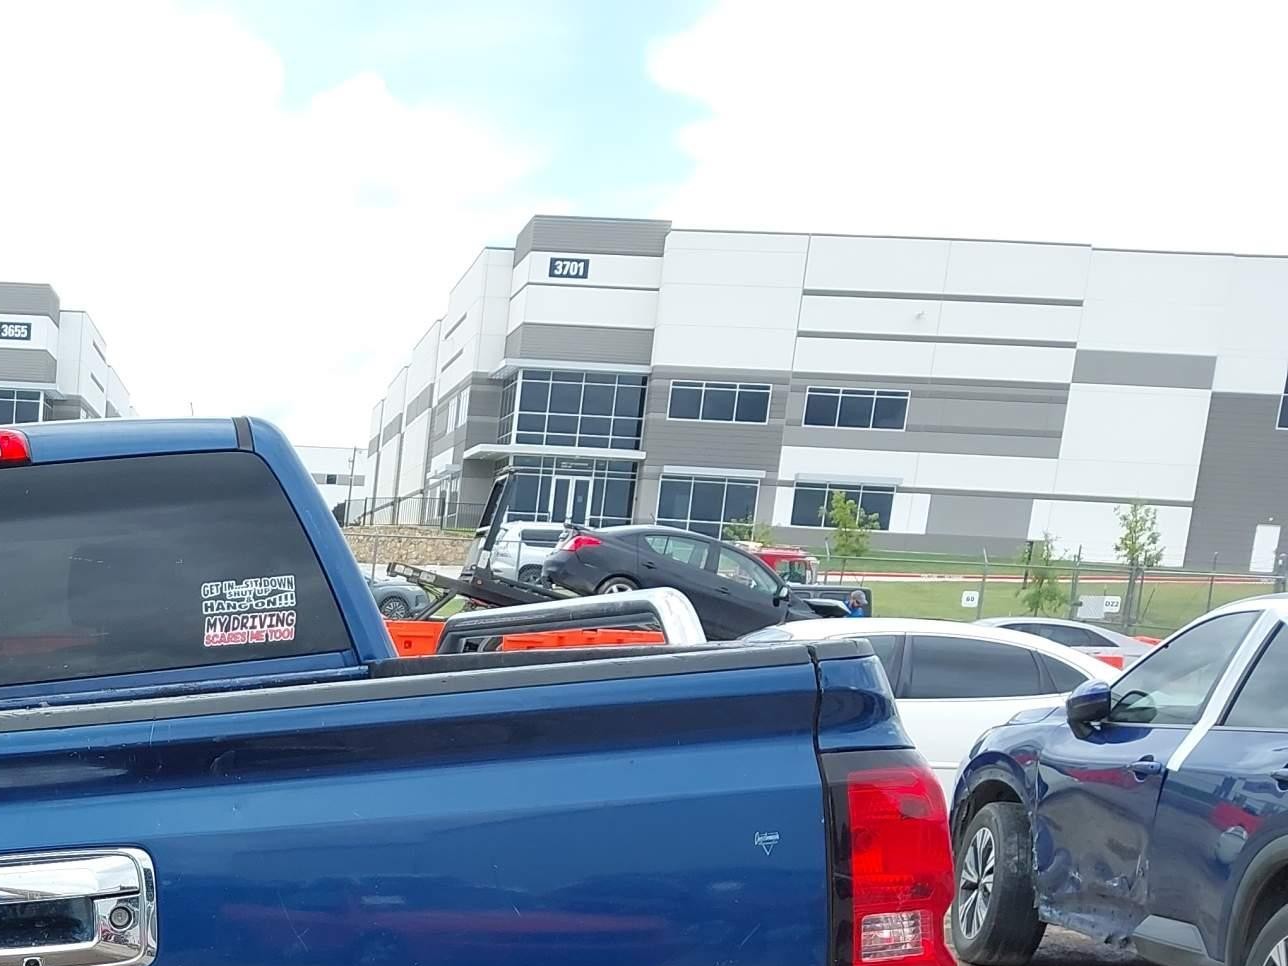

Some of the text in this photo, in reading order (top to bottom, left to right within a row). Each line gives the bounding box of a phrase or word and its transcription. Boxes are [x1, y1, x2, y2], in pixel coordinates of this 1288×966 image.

[554, 260, 585, 276] 3701
[1, 324, 28, 338] 3655
[203, 583, 220, 597] GET
[245, 580, 260, 589] SIT
[263, 576, 295, 590] DOWN
[227, 589, 253, 599] SHUT
[204, 601, 250, 613] HANG
[207, 612, 295, 633] MY DRIVING
[205, 631, 248, 645] SCARES
[250, 630, 266, 642] ME
